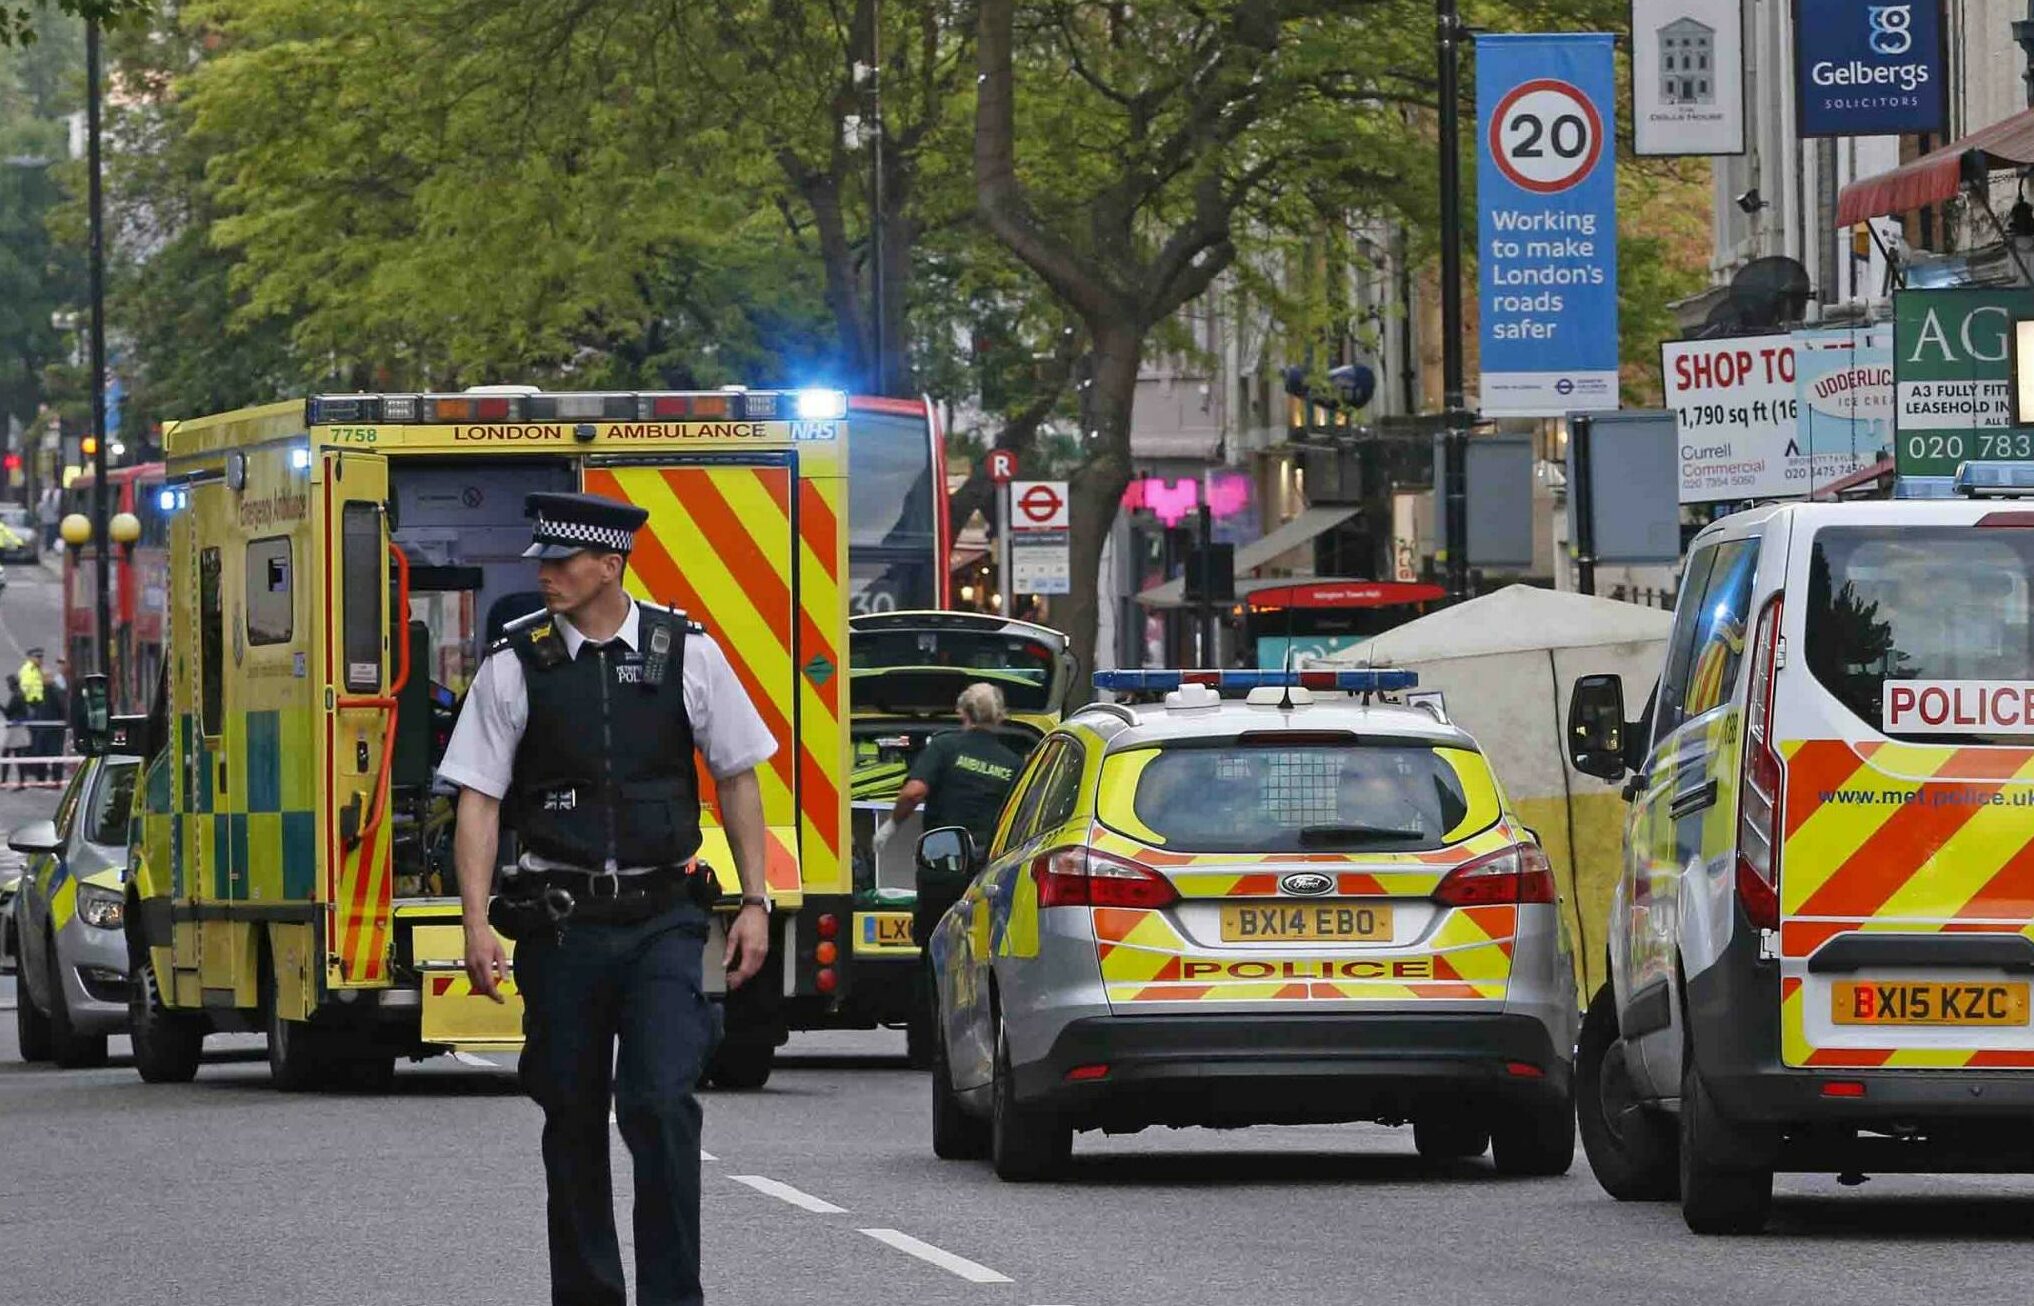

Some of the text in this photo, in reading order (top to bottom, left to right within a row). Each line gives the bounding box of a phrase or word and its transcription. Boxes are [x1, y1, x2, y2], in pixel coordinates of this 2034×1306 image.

[1812, 61, 1929, 91] Gelbergs
[1825, 96, 1918, 109] SOLICITORS
[1510, 114, 1587, 158] 20
[1492, 210, 1596, 235] Working
[1492, 237, 1594, 258] to make
[1493, 264, 1604, 285] London's
[1493, 291, 1564, 312] roads
[1493, 318, 1557, 339] safer
[1675, 347, 1796, 391] SHOP TO
[1911, 385, 1932, 397] A3
[1937, 384, 1977, 397] FULLY
[1838, 397, 1858, 407] ICE
[1906, 401, 1990, 414] LEASEHOLD
[1679, 404, 1724, 429] 1,790
[1729, 407, 1749, 428] sq
[1752, 400, 1768, 421] ft
[1984, 418, 2001, 426] ALL
[330, 428, 377, 442] 7758
[454, 423, 767, 440] LONDON AMBULANCE
[791, 421, 836, 439] NHS
[1681, 443, 1732, 461] Currell
[1909, 434, 2031, 459] 020 783
[994, 456, 1009, 476] R
[1682, 458, 1766, 478] Commercial
[1784, 468, 1806, 479] 020
[954, 755, 1013, 782] AMBULANCE
[879, 919, 912, 939] LX
[1239, 909, 1375, 935] BX14 EBO
[1184, 960, 1432, 979] POLICE
[1853, 987, 2008, 1019] BX15 KZC
